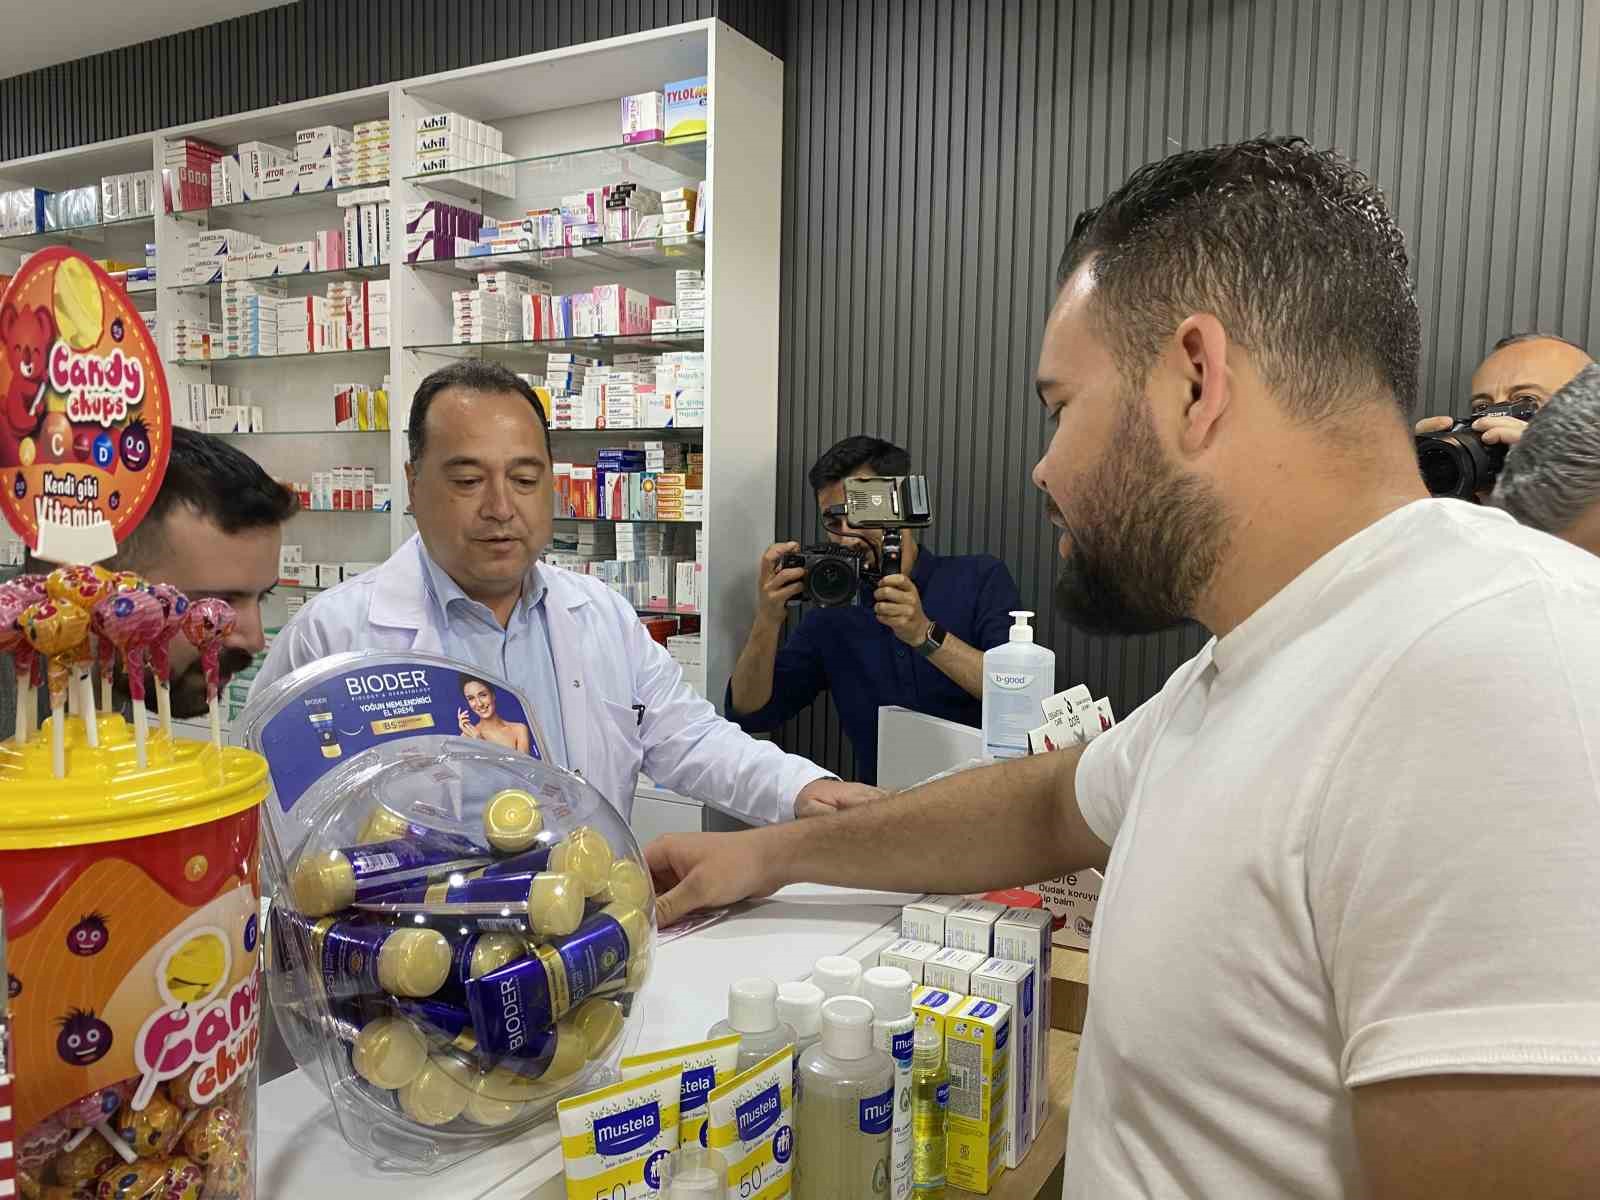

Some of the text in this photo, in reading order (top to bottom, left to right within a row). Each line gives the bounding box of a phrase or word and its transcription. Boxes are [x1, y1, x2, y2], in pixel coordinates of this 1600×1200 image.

[421, 116, 447, 129] Advil
[298, 131, 315, 140] ATOR
[421, 137, 446, 150] Advil
[265, 168, 284, 179] ATOR
[300, 163, 317, 172] ATOR
[421, 159, 446, 171] Advil
[52, 348, 141, 399] Candy
[71, 391, 124, 421] chups
[52, 433, 64, 456] C
[99, 447, 108, 462] D
[44, 474, 97, 501] Kendi gibi
[35, 497, 104, 528] Vitamin
[345, 670, 429, 695] BIODER
[996, 674, 1025, 685] b-good
[1039, 884, 1065, 896] Dudak
[1053, 896, 1075, 907] balm
[143, 967, 262, 1073] Can
[500, 976, 524, 1051] BIODER
[680, 1078, 710, 1095] stela
[738, 1096, 779, 1130] mustela
[598, 1113, 656, 1142] mustela
